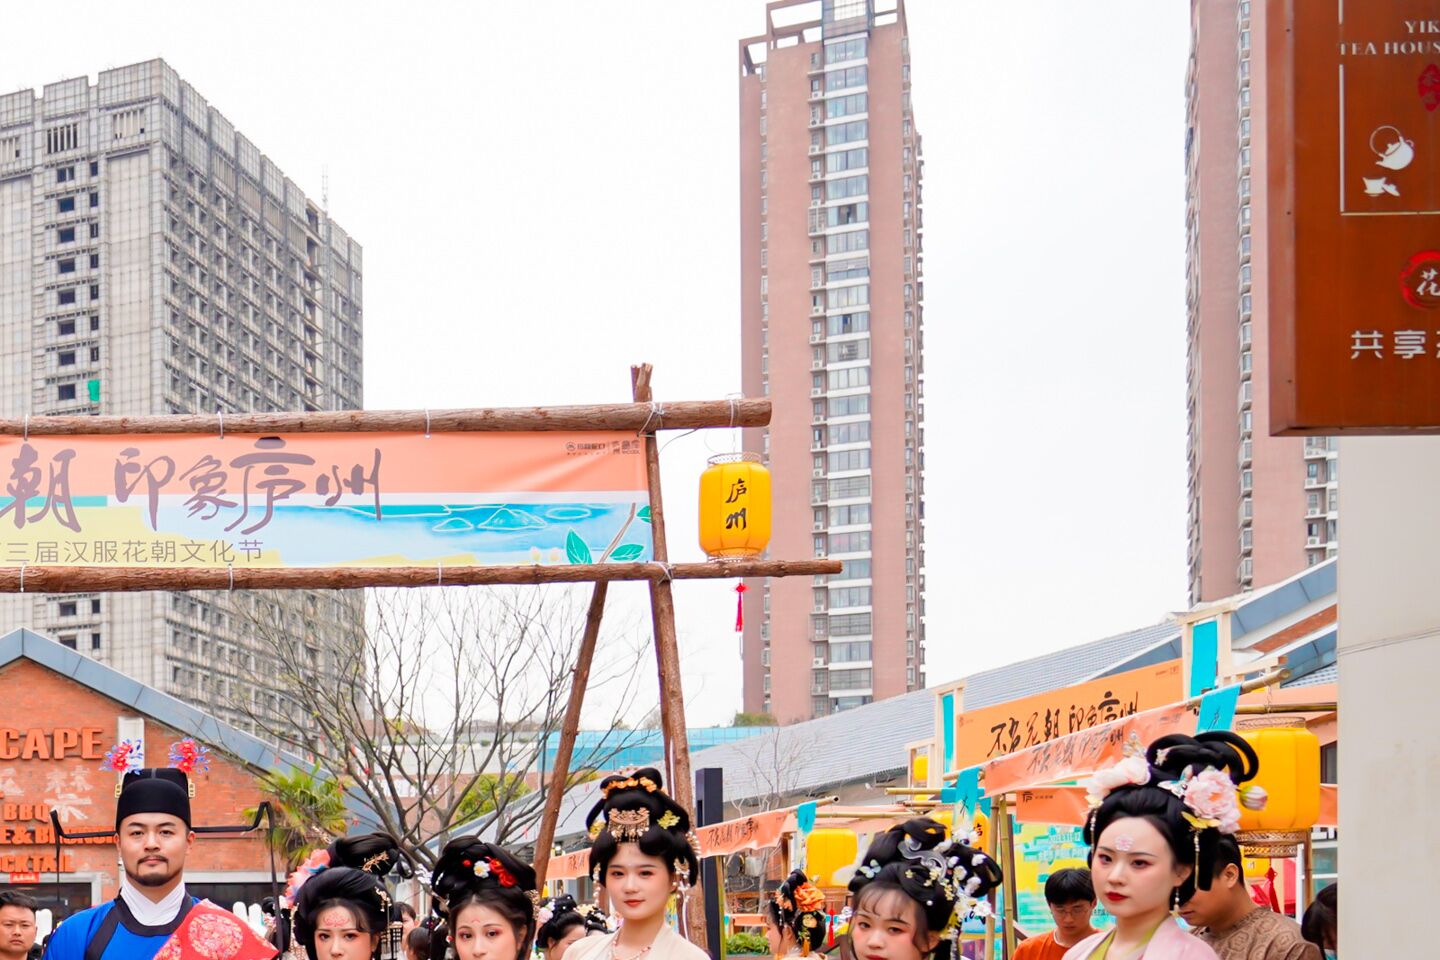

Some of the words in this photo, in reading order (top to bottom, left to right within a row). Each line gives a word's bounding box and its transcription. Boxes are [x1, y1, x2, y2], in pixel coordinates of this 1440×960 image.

[1337, 42, 1377, 55] TEA
[1351, 330, 1440, 359] 共享
[113, 437, 383, 535] 印象庐州
[725, 478, 747, 530] 庐州
[987, 708, 1060, 759] 不负花朝
[3, 803, 49, 824] BBQ
